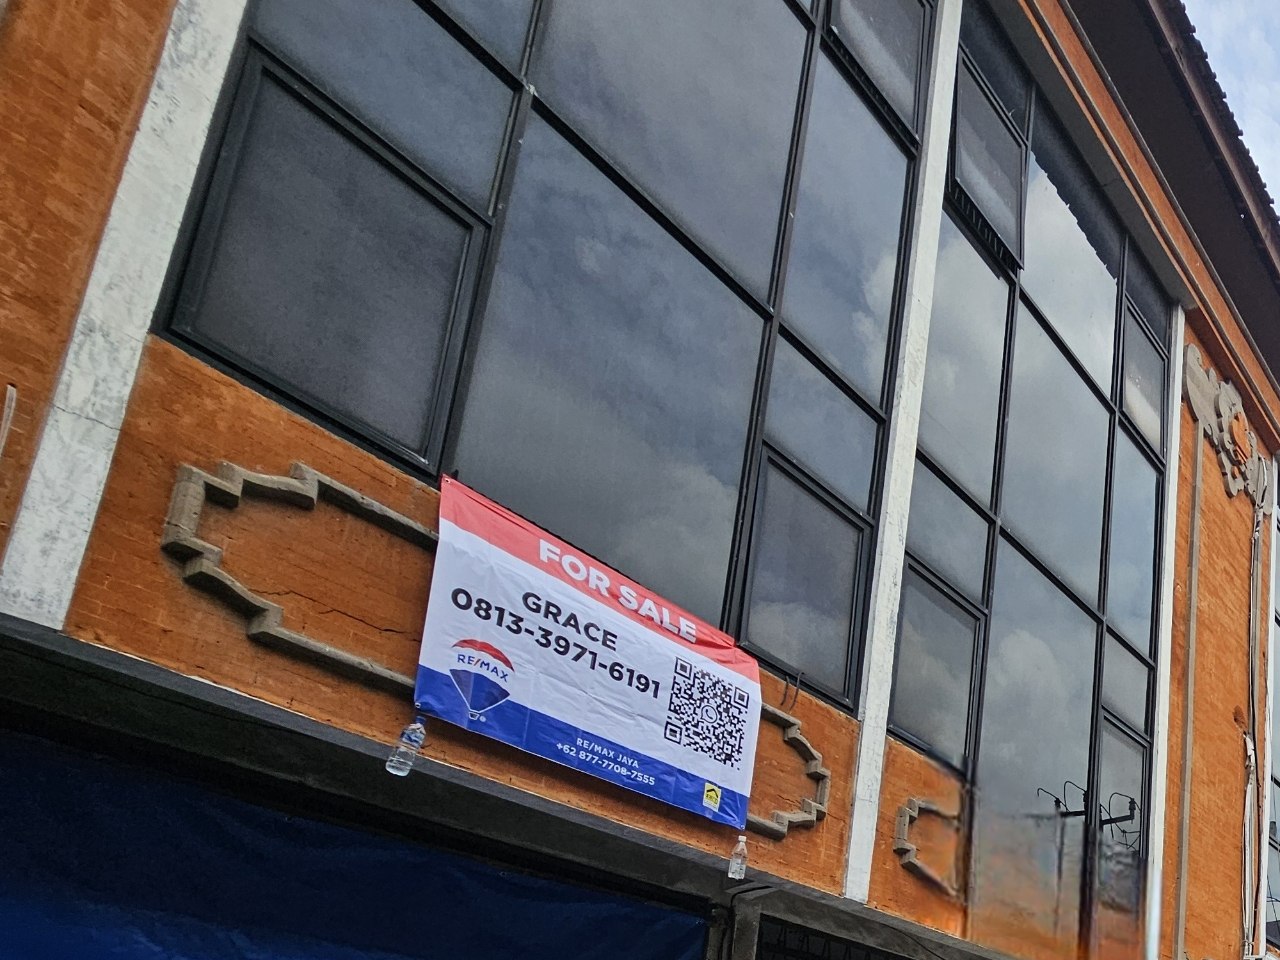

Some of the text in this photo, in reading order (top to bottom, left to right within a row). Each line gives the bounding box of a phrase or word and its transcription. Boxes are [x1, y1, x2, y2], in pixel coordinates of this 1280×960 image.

[538, 538, 698, 644] FOR SALE
[450, 587, 661, 700] 0813-3971-6191
[521, 591, 619, 652] GRACE
[456, 652, 510, 683] RE/MAX
[555, 741, 656, 787] +62 877-7708-7555
[575, 737, 640, 769] RE/MAX JAYA
